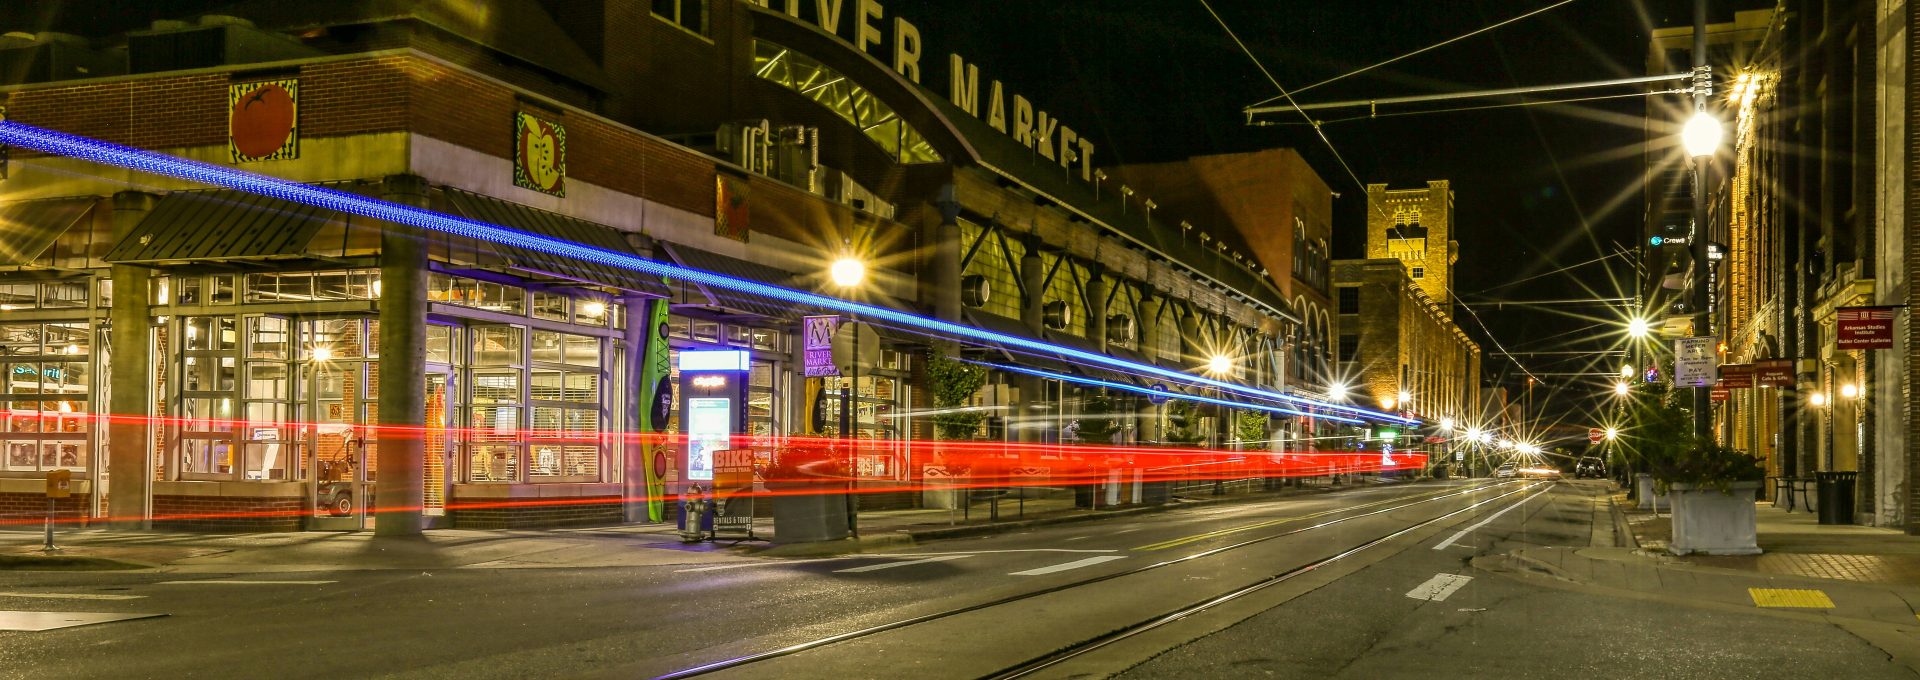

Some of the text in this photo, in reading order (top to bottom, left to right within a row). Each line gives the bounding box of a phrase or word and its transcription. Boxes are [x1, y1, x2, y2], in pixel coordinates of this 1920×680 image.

[950, 53, 1095, 182] MARKET
[714, 451, 752, 467] BIKE
[713, 516, 732, 524] RENTALS
